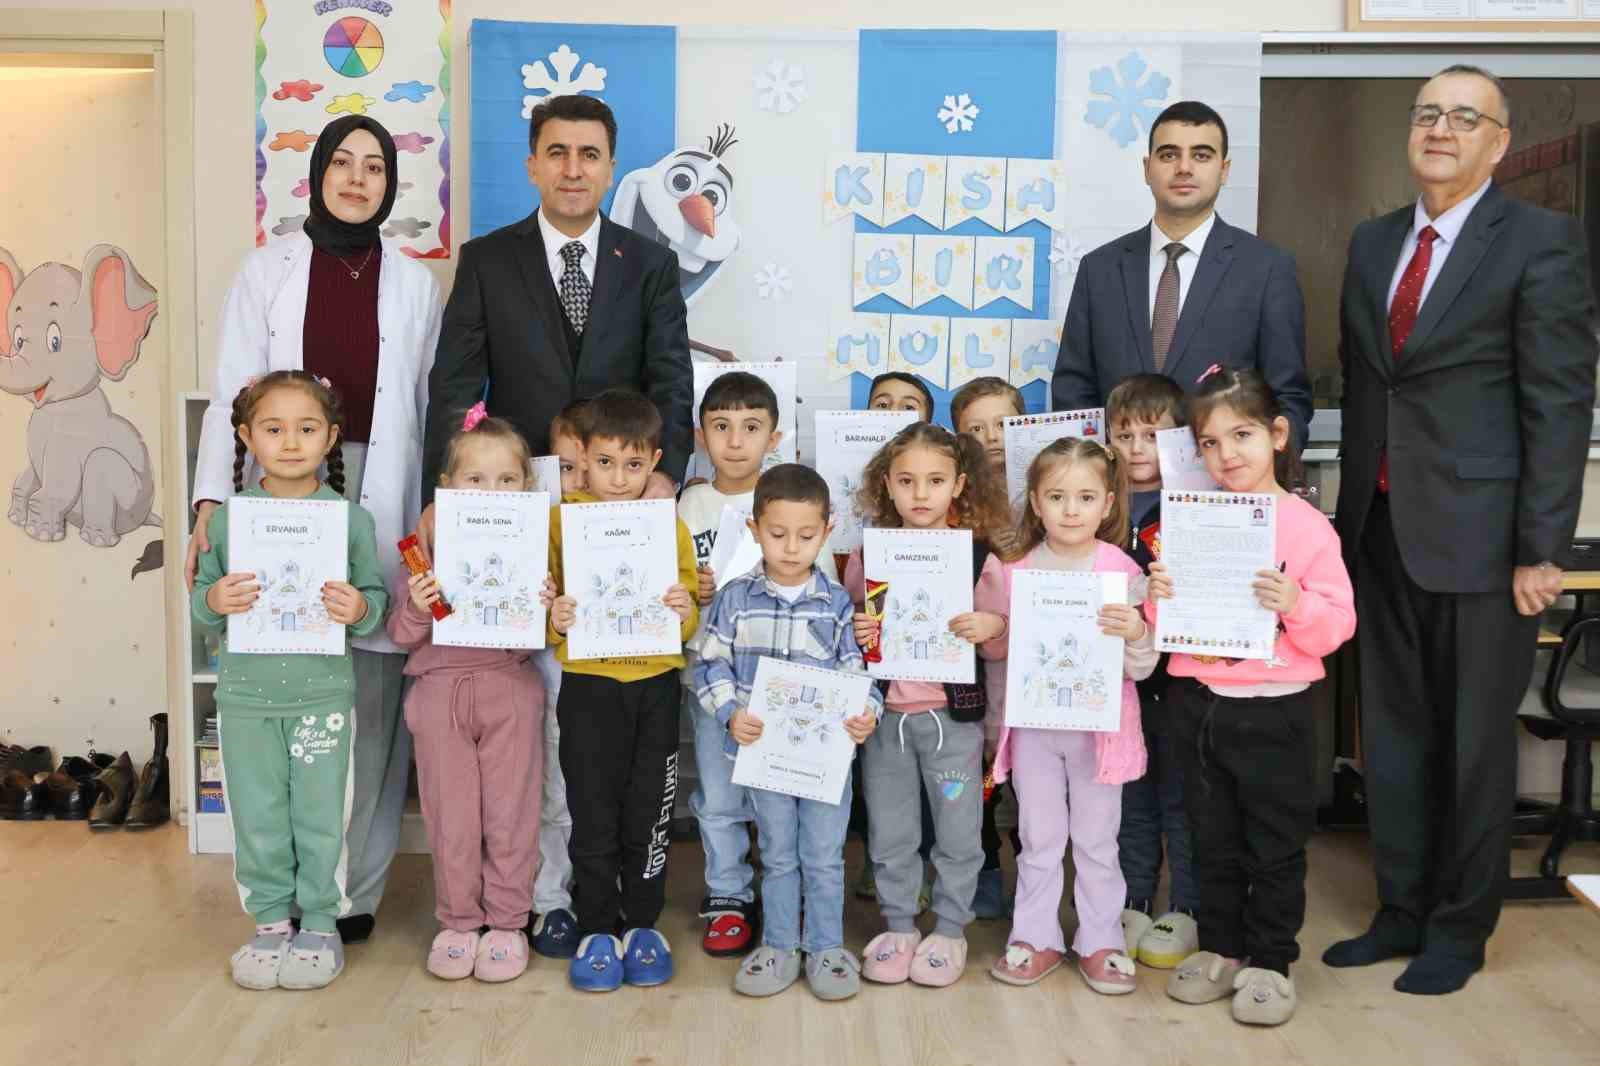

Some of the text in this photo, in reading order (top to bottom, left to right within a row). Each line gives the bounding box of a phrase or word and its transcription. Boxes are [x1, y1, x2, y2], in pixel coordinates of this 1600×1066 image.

[835, 164, 1055, 212] KISA
[836, 330, 1059, 373] MOLA
[265, 525, 309, 534] ERVANUR
